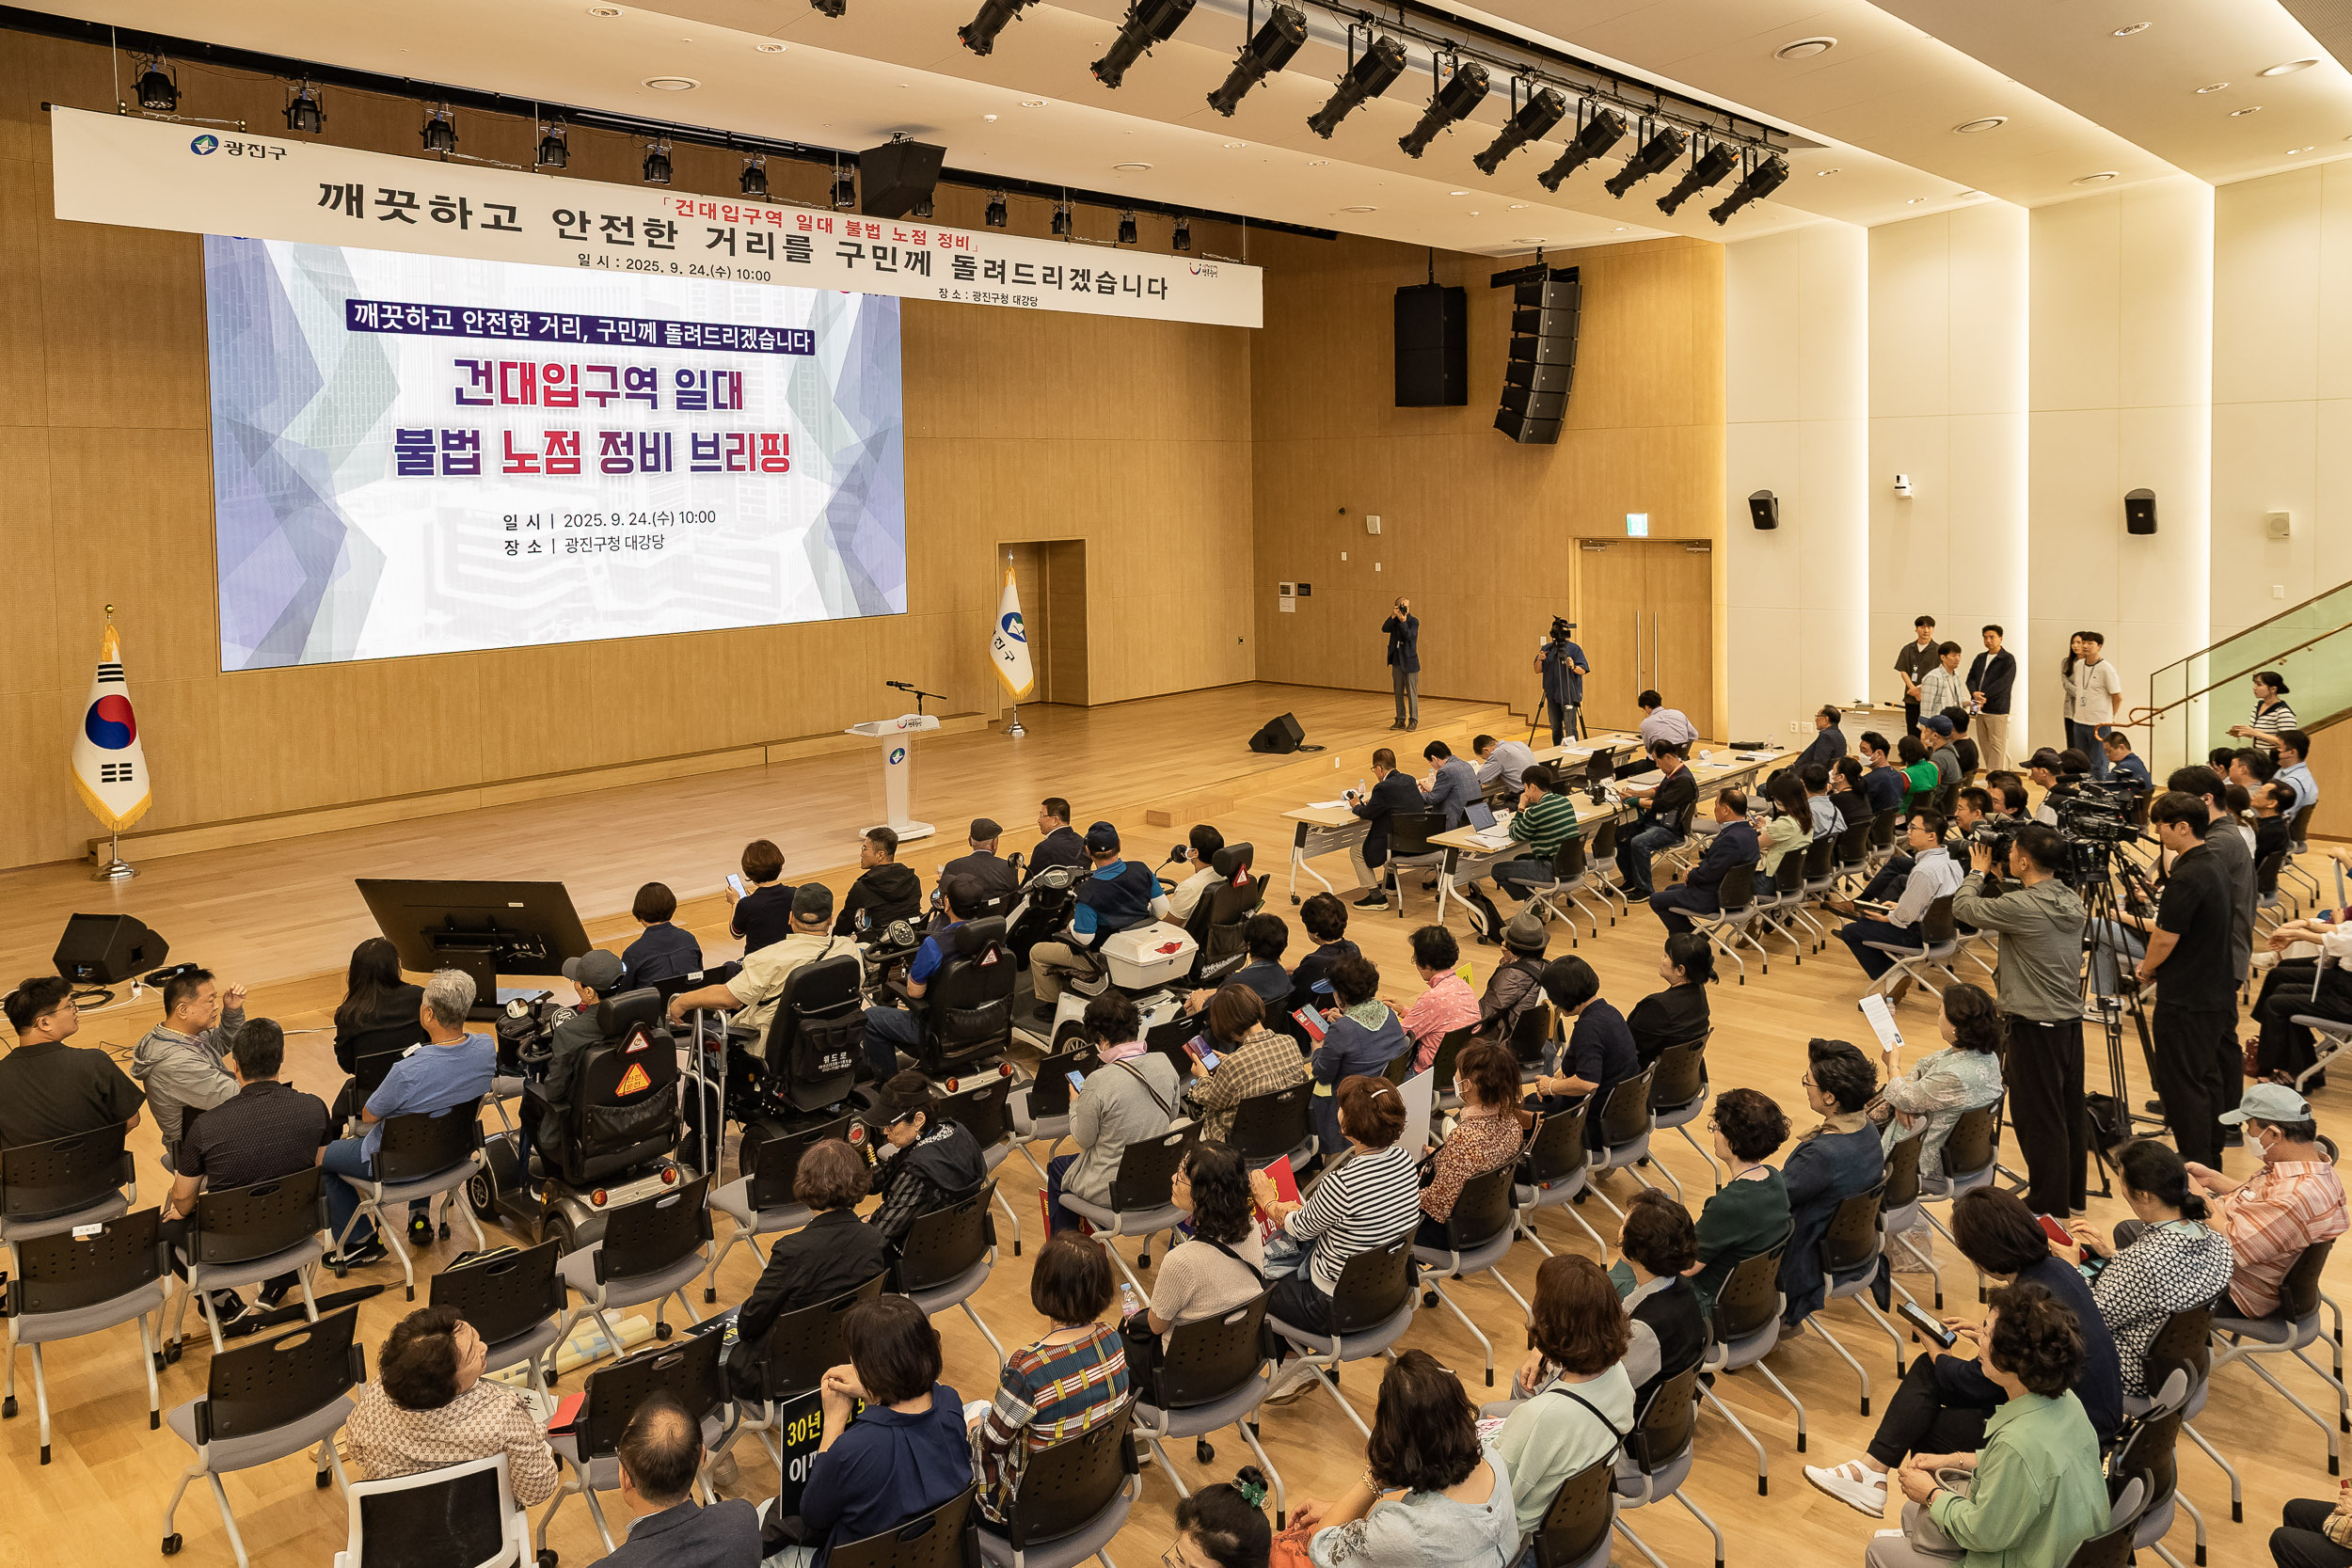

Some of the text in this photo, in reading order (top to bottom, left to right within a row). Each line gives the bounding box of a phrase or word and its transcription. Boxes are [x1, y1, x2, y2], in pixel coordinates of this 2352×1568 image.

[224, 139, 288, 161] 광진구
[318, 182, 1168, 301] 깨끗하고 안전한 거리를 구민께 돌려드리겠습니다
[795, 214, 834, 234] 일대
[845, 219, 882, 242] 불법
[892, 227, 927, 245] 노점
[626, 258, 664, 273] 2025.
[670, 262, 683, 275] 9.
[689, 263, 732, 279] 24.(수)
[737, 268, 771, 282] 10:00
[972, 290, 1009, 305] 광진구청
[1012, 293, 1039, 307] 대강당
[354, 303, 811, 353] 깨끗하고 안전한 거리, 구민께 돌려드리겠습니다
[453, 357, 744, 412] 건대입구역 일대
[393, 427, 791, 477] 불법 노점 정비 브리핑
[564, 514, 607, 528] 2025.
[612, 513, 625, 527] 9.
[628, 511, 675, 528] 24.(수)
[678, 510, 717, 525] 10:00
[564, 535, 620, 554] 광진구청
[625, 533, 665, 551] 대강당
[787, 1410, 820, 1447] 30년
